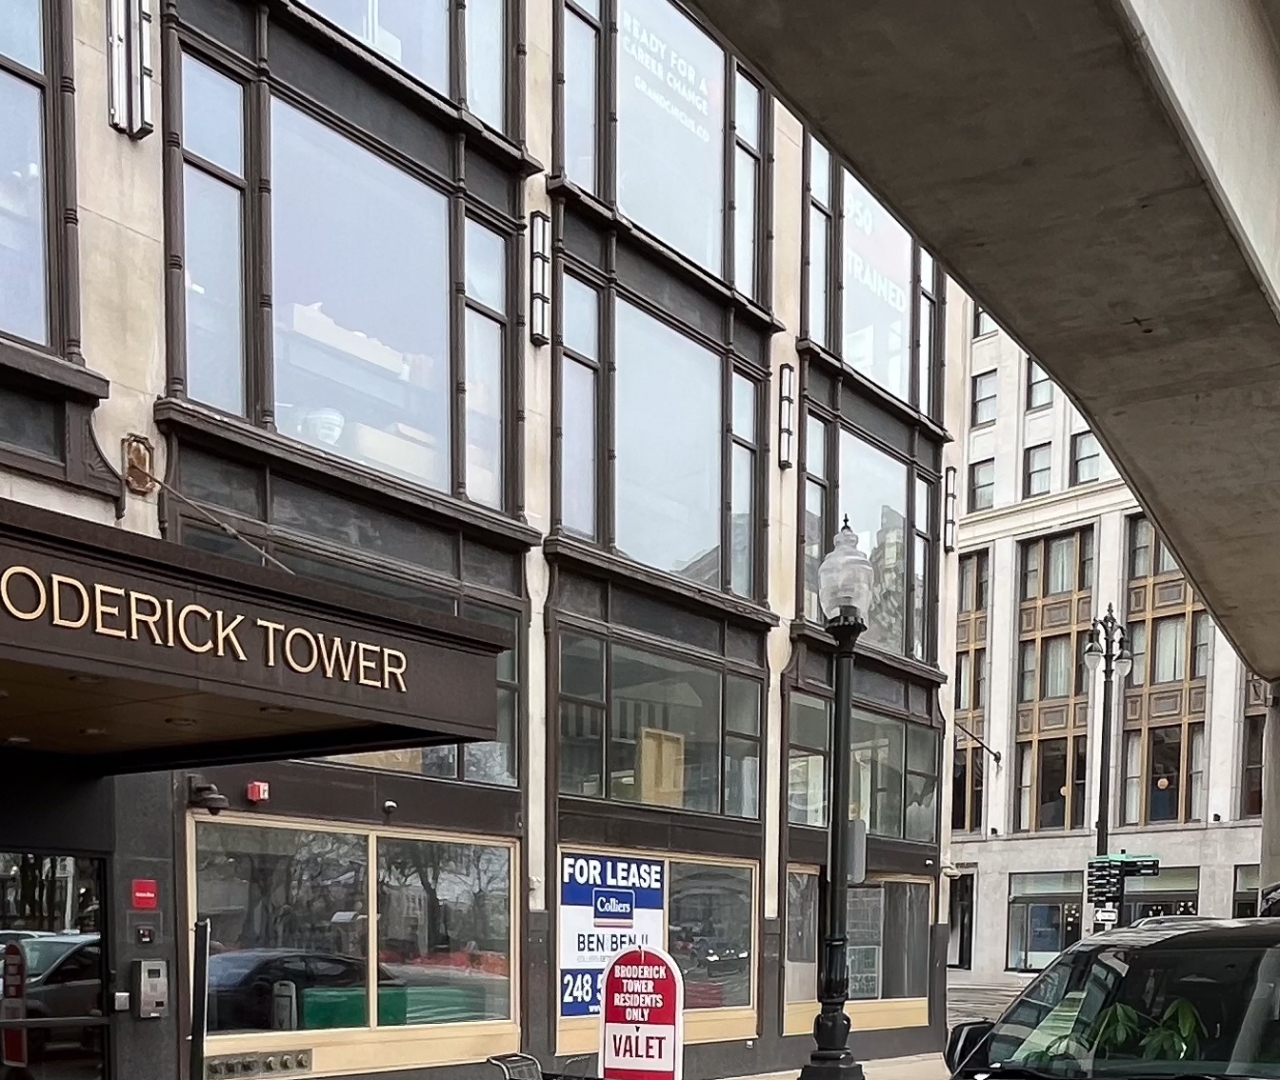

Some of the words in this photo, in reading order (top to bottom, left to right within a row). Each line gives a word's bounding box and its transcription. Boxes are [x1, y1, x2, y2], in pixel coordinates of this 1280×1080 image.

[623, 9, 667, 60] READY
[669, 50, 696, 86] FOR
[699, 77, 708, 96] A
[622, 35, 664, 81] CAREER
[666, 71, 709, 116] CHANGE
[846, 246, 908, 313] TRAINED
[256, 618, 409, 692] TOWER
[563, 857, 602, 885] FOR
[606, 861, 662, 889] LEASE
[596, 896, 631, 913] Colliers
[578, 933, 605, 952] BEN
[614, 965, 667, 980] BRODERICK
[563, 973, 592, 1003] 248
[622, 979, 654, 993] TOWER
[614, 993, 664, 1007] RESIDENTS
[625, 1008, 650, 1022] ONLY
[612, 1034, 667, 1059] VALET
